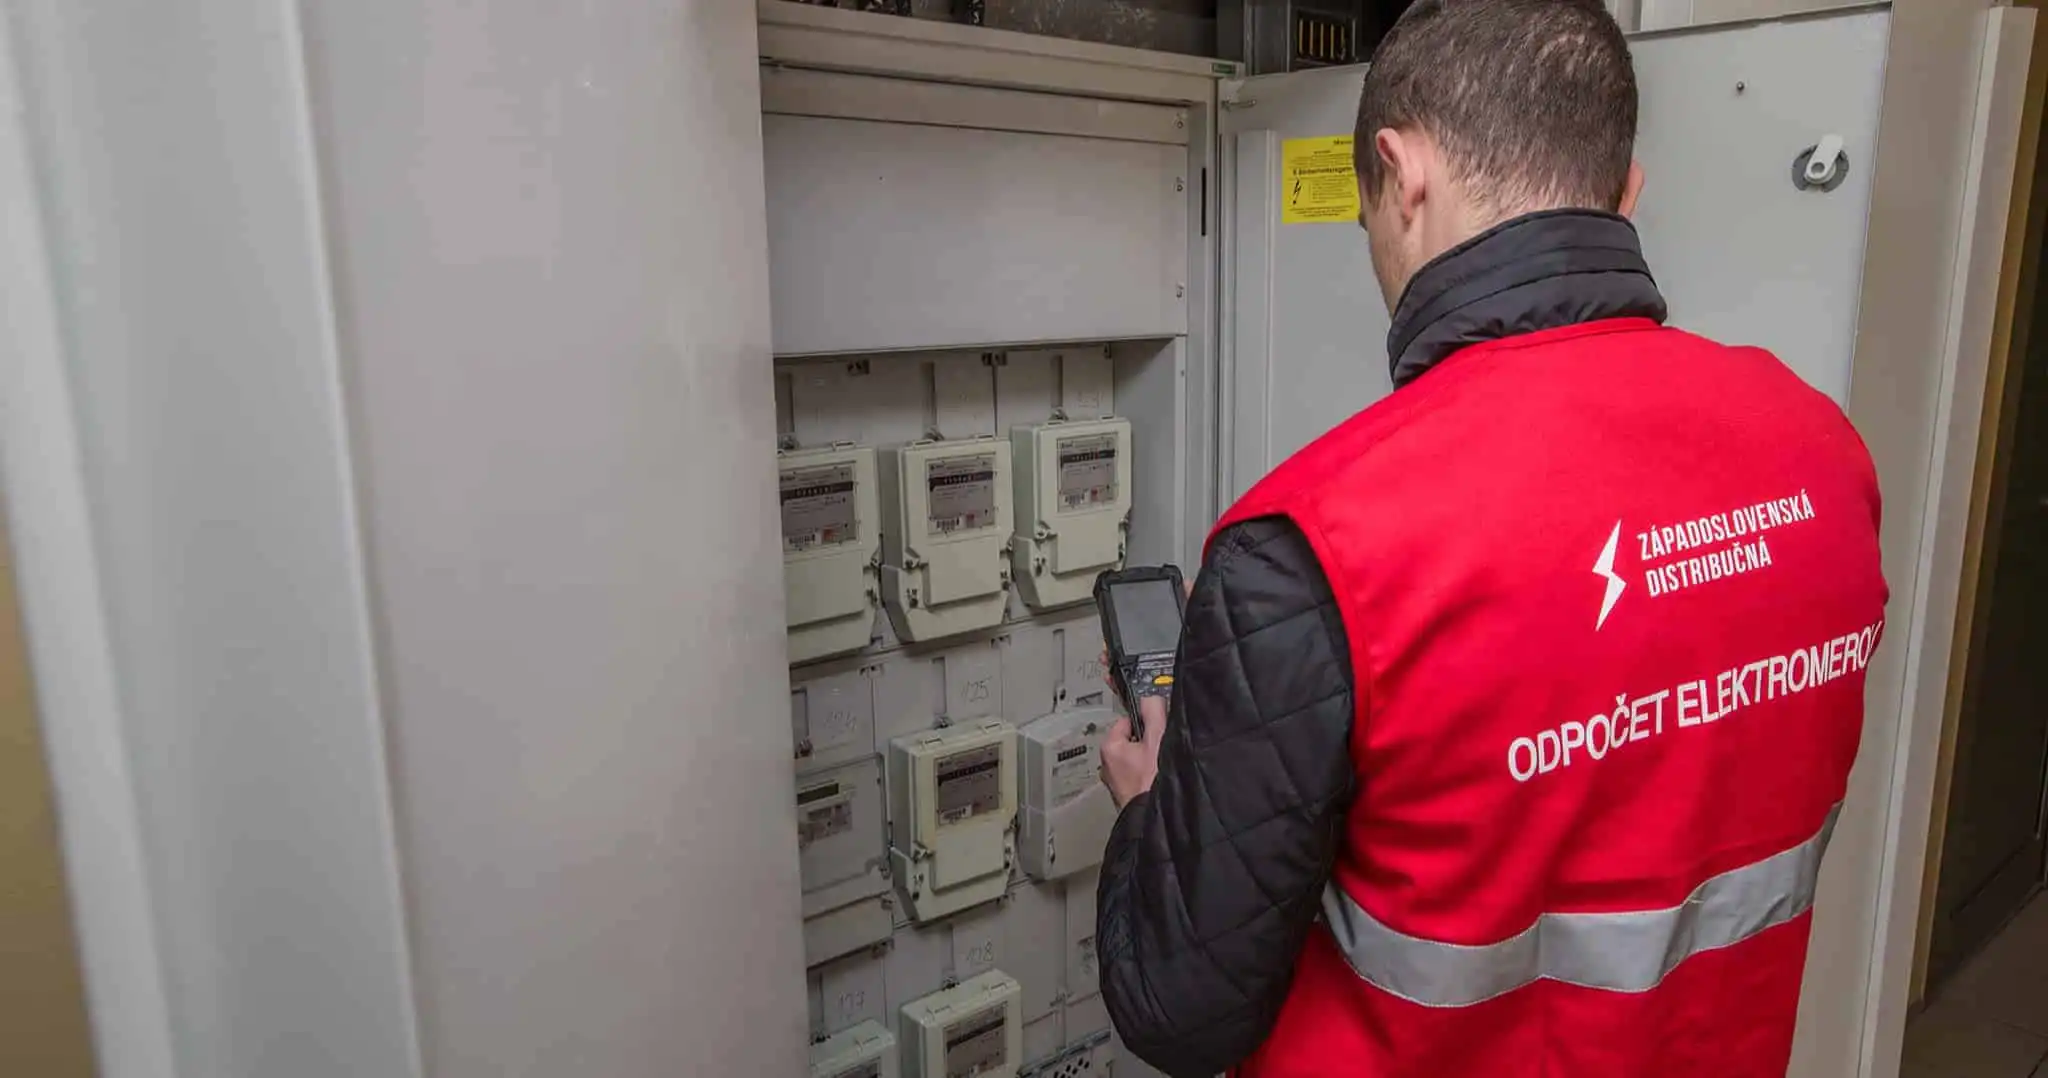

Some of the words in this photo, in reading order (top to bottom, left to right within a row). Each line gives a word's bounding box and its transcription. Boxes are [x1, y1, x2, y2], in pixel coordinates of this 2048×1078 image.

[1637, 489, 1815, 561] ZÁPADOSLOVENSKÁ
[1645, 535, 1772, 597] DISTRIBUČNÁ
[1508, 690, 1670, 781] ODPOČET
